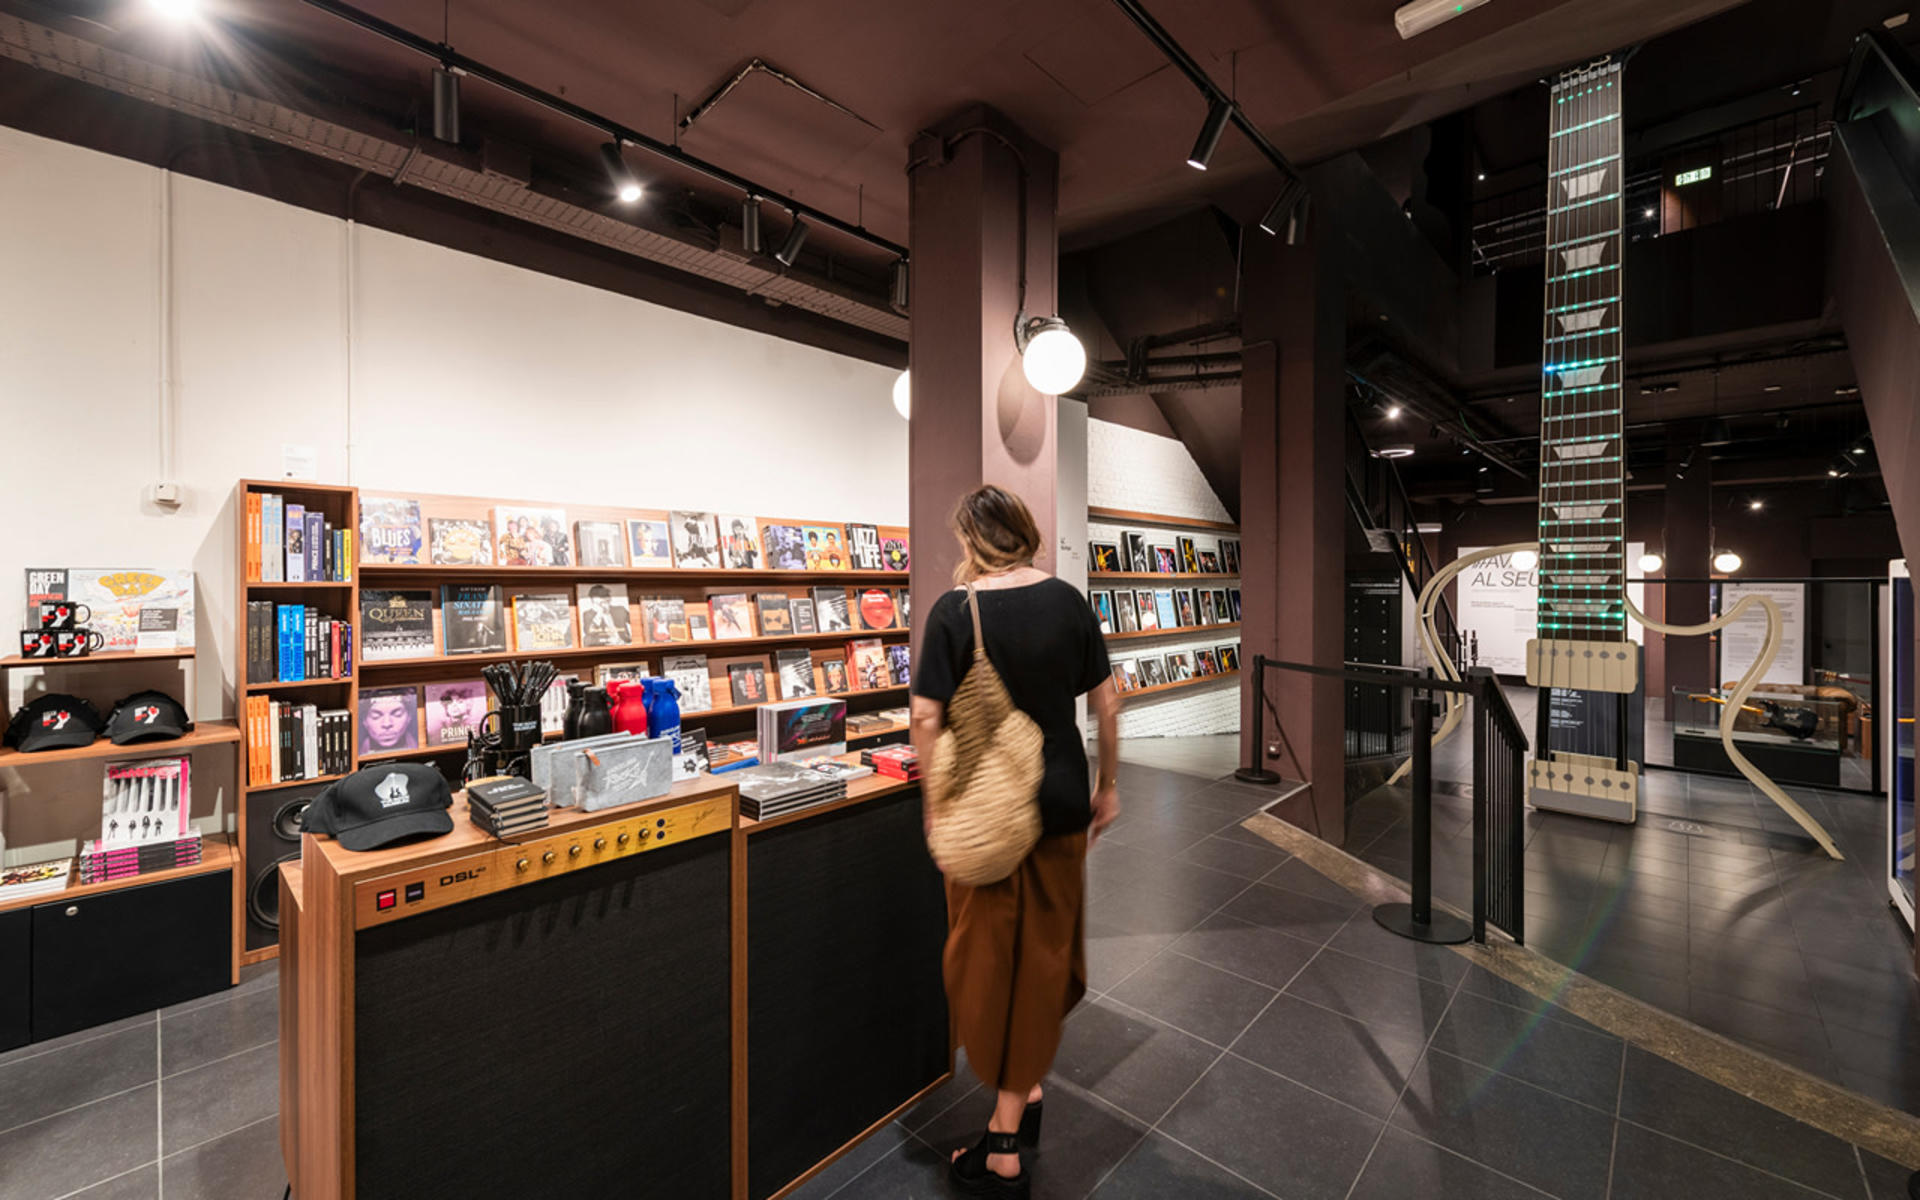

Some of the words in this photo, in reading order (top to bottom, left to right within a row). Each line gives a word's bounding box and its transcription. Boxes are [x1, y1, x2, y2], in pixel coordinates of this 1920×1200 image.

[371, 527, 411, 548] BLUES
[858, 546, 882, 569] LIFE
[29, 572, 65, 584] GREEN
[1471, 571, 1496, 587] AL
[29, 583, 51, 594] DAY
[369, 607, 425, 623] QUEEN
[441, 725, 480, 738] PRINCE
[109, 765, 178, 780] RAMONES
